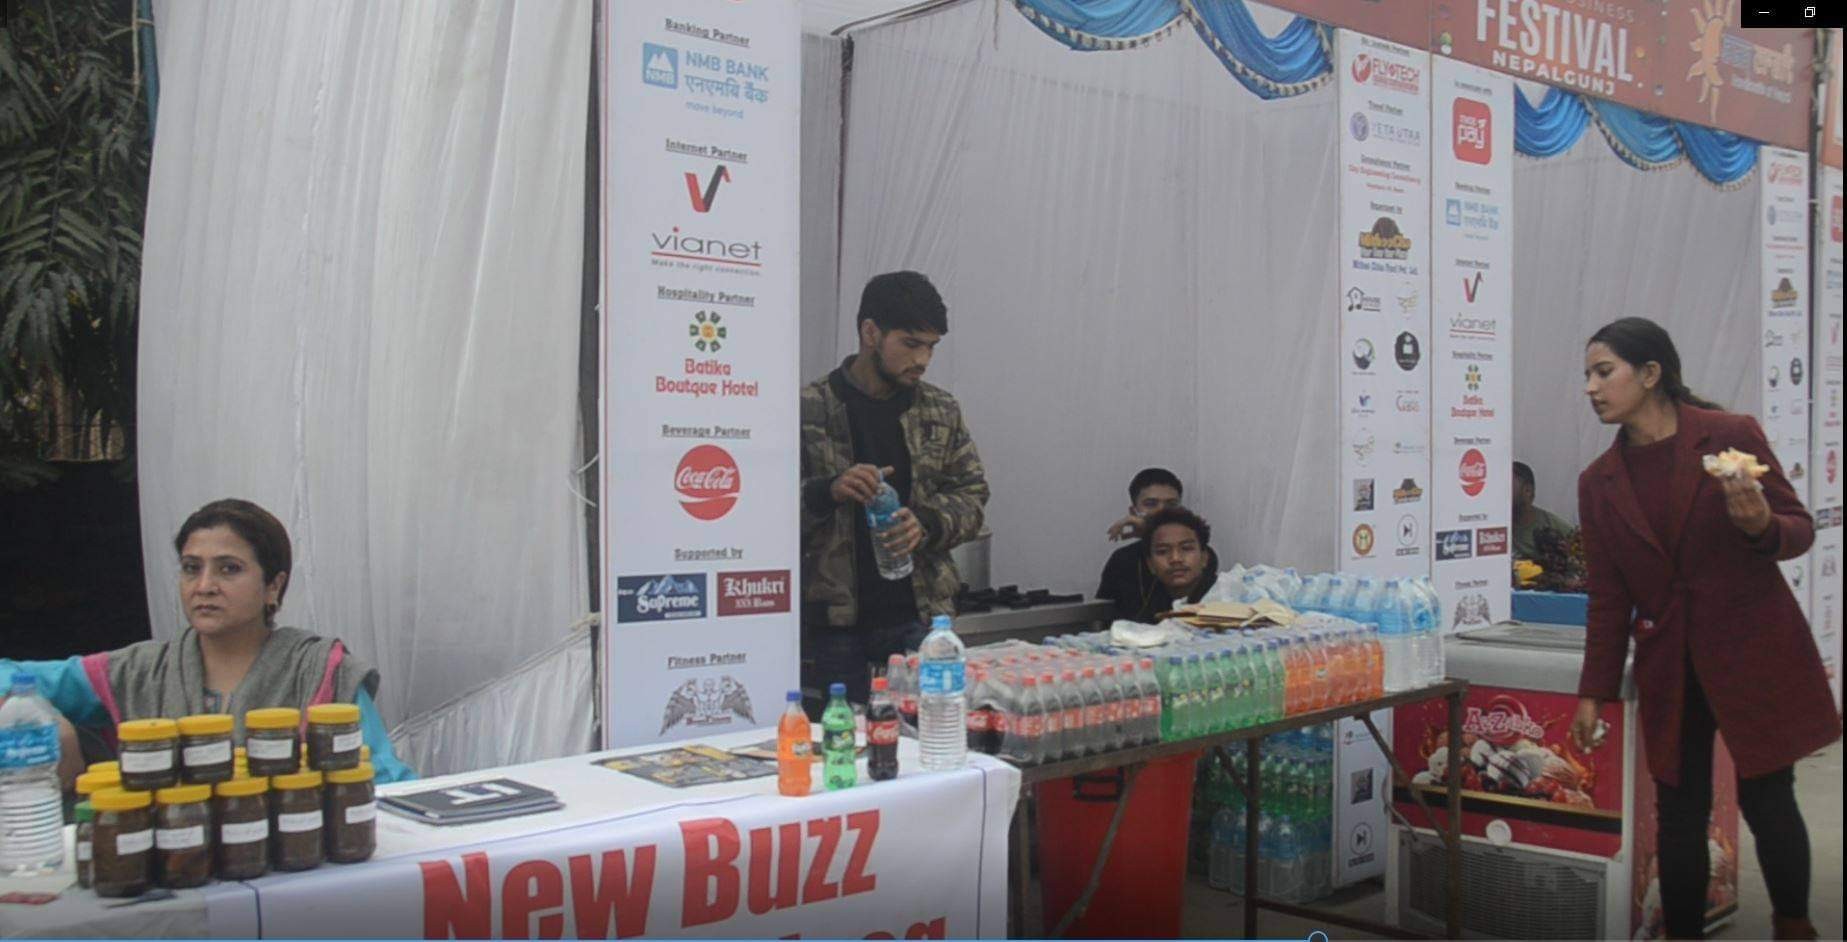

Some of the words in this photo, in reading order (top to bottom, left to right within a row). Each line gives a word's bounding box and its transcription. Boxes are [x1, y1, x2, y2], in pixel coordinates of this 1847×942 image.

[665, 18, 709, 39] Banking
[712, 29, 750, 46] Partner
[1477, 0, 1634, 82] FESTIVAL
[685, 51, 721, 71] NMB
[725, 60, 769, 82] BANK
[712, 104, 744, 119] beyond
[666, 138, 708, 155] Internet
[711, 146, 748, 161] Partner
[652, 226, 763, 260] vianet
[657, 286, 715, 303] Hospitality
[719, 292, 755, 304] Partner
[685, 358, 732, 376] Batika
[656, 376, 718, 399] Boutque
[722, 380, 759, 397] Hotel
[661, 425, 711, 437] Beverage
[714, 426, 751, 437] Partner
[674, 548, 727, 561] Supported
[731, 547, 743, 560] by
[723, 577, 785, 601] Khukri
[636, 593, 699, 614] Supreme
[668, 656, 706, 668] Fitness
[710, 652, 747, 664] Partner
[418, 844, 657, 940] New
[679, 808, 882, 929] Buzz
